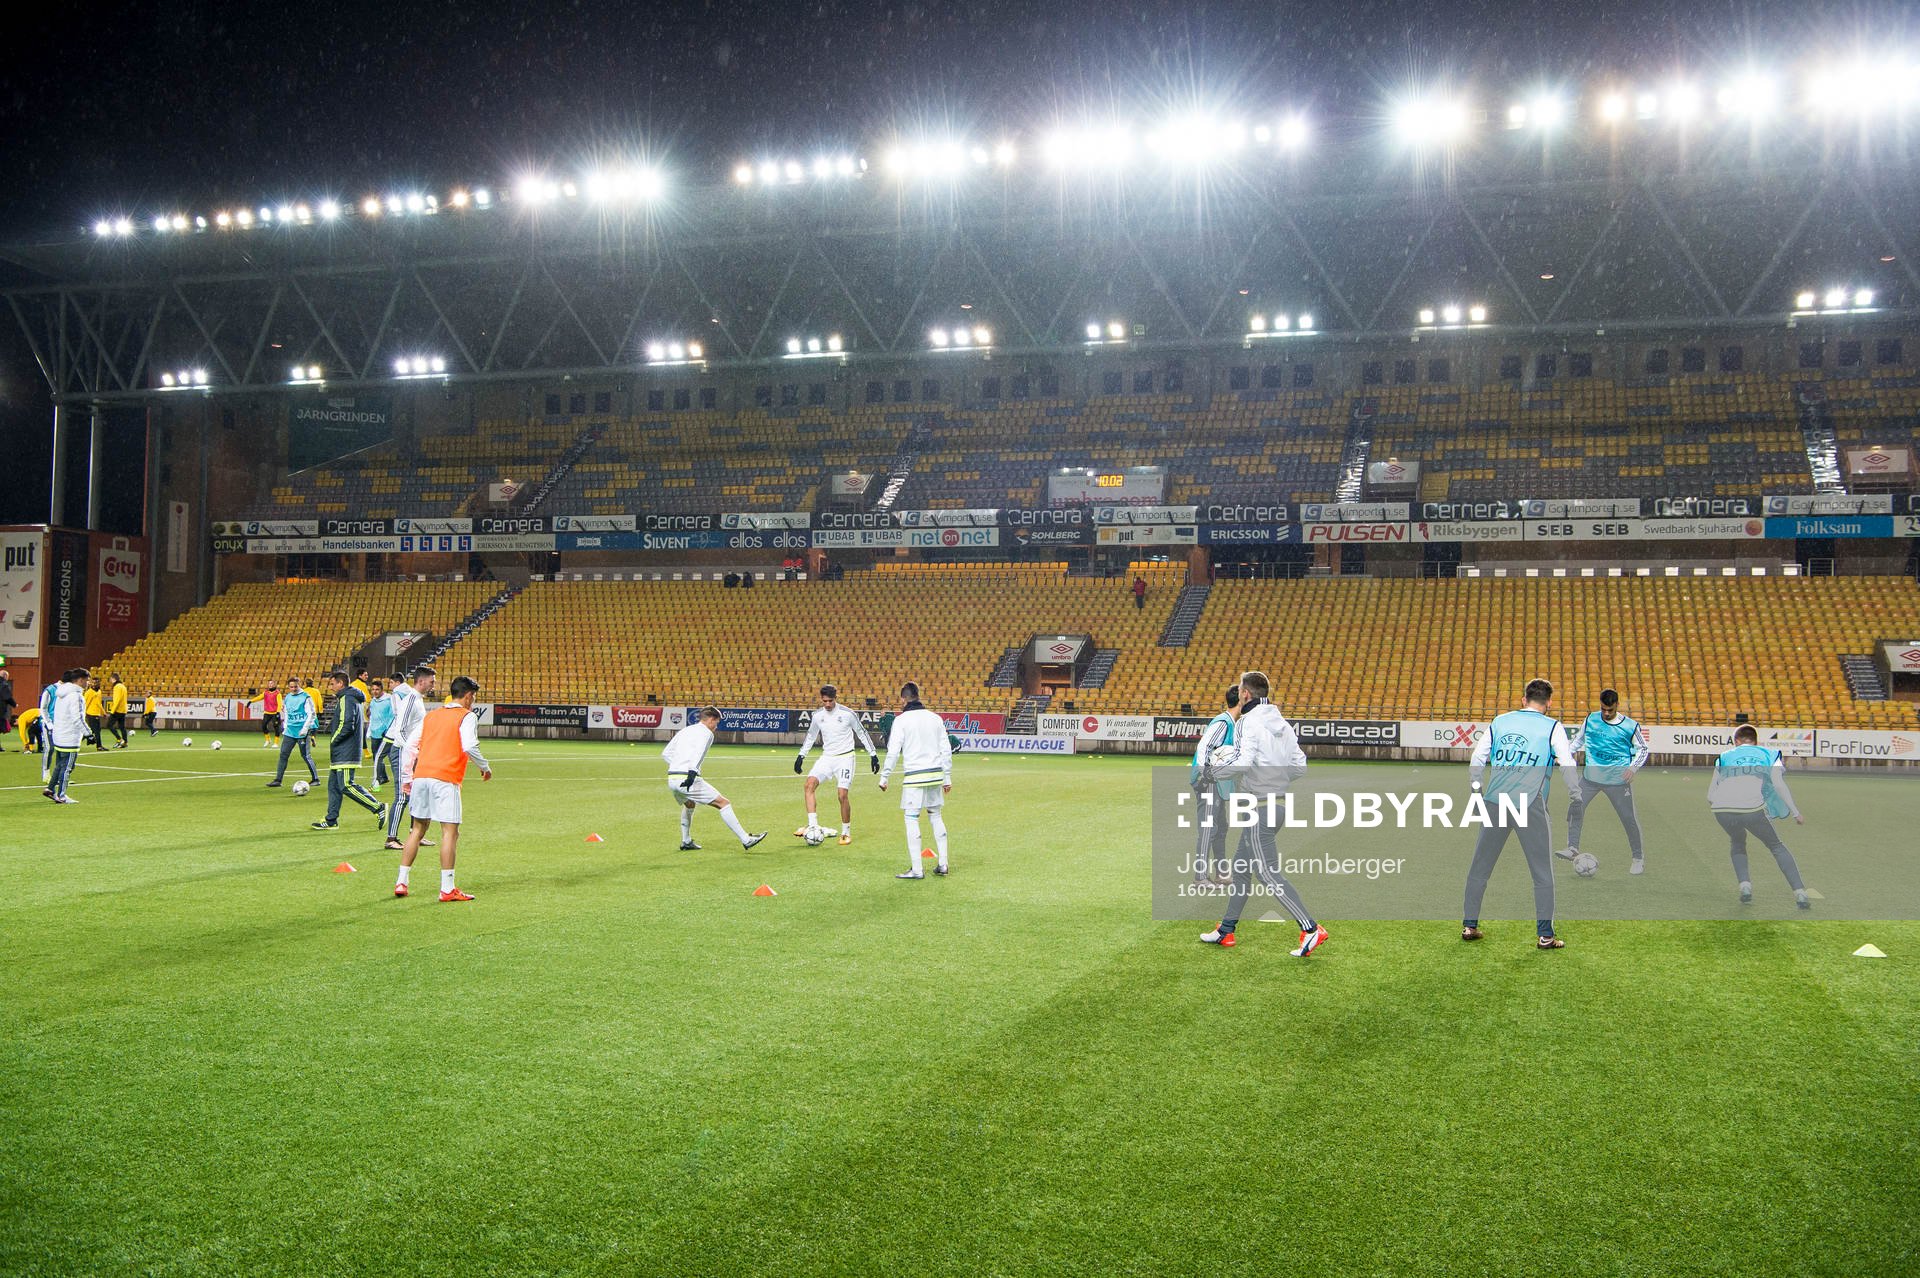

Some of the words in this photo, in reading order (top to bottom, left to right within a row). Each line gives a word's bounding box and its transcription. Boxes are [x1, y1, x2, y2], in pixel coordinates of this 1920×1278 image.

[297, 407, 385, 424] JÄRNGRINDEN
[1208, 505, 1287, 521] Cernera
[1423, 502, 1508, 518] Cernera
[1655, 498, 1748, 515] Cernera
[646, 515, 711, 529] Cernera
[822, 513, 890, 527] Cernera
[1008, 509, 1081, 525] Cernera
[328, 520, 385, 533] Cernera
[482, 518, 543, 532] Cernera
[1433, 524, 1517, 539] Riksbyggen
[1537, 525, 1574, 536] SEB
[1592, 524, 1629, 535] SEB
[1644, 524, 1695, 534] Swedbank
[1698, 523, 1743, 535] Sjuhärad
[1796, 520, 1861, 535] Folksam
[828, 532, 855, 540] UBAB
[875, 531, 903, 540] UBAB
[1031, 531, 1081, 540] SOHLBERG
[1118, 530, 1135, 543] put
[1211, 529, 1270, 539] ERICSSON
[1309, 524, 1405, 541] PULSEN
[214, 540, 243, 552] onyx
[322, 540, 395, 550] Handelsbanken
[643, 533, 691, 549] SILVENT
[730, 531, 763, 548] ellos
[773, 531, 807, 548] ellos
[5, 542, 35, 571] put
[104, 556, 136, 578] City
[59, 560, 72, 642] DIDRIKSONS
[106, 603, 131, 616] 7-23
[127, 703, 143, 713] EAM
[495, 706, 536, 715] Service
[539, 707, 568, 716] Team
[569, 707, 587, 716] AB
[721, 710, 763, 720] Sjömarkens
[764, 712, 786, 720] Svets
[726, 720, 739, 728] och
[741, 720, 764, 729] Smide
[766, 720, 780, 729] AB
[1042, 718, 1080, 730] COMFORT
[1106, 719, 1112, 727] Vi
[1114, 719, 1148, 727] installerar
[1127, 730, 1146, 739] säljer
[1501, 733, 1526, 746] UEFA
[1673, 734, 1734, 745] SIMONSLA
[974, 738, 1016, 749] YOUTH
[1018, 739, 1065, 750] LEAGUE
[1820, 740, 1890, 755] ProFlow
[1495, 749, 1540, 767] OUTH
[841, 768, 850, 779] 12
[1495, 764, 1524, 773] EAGUE
